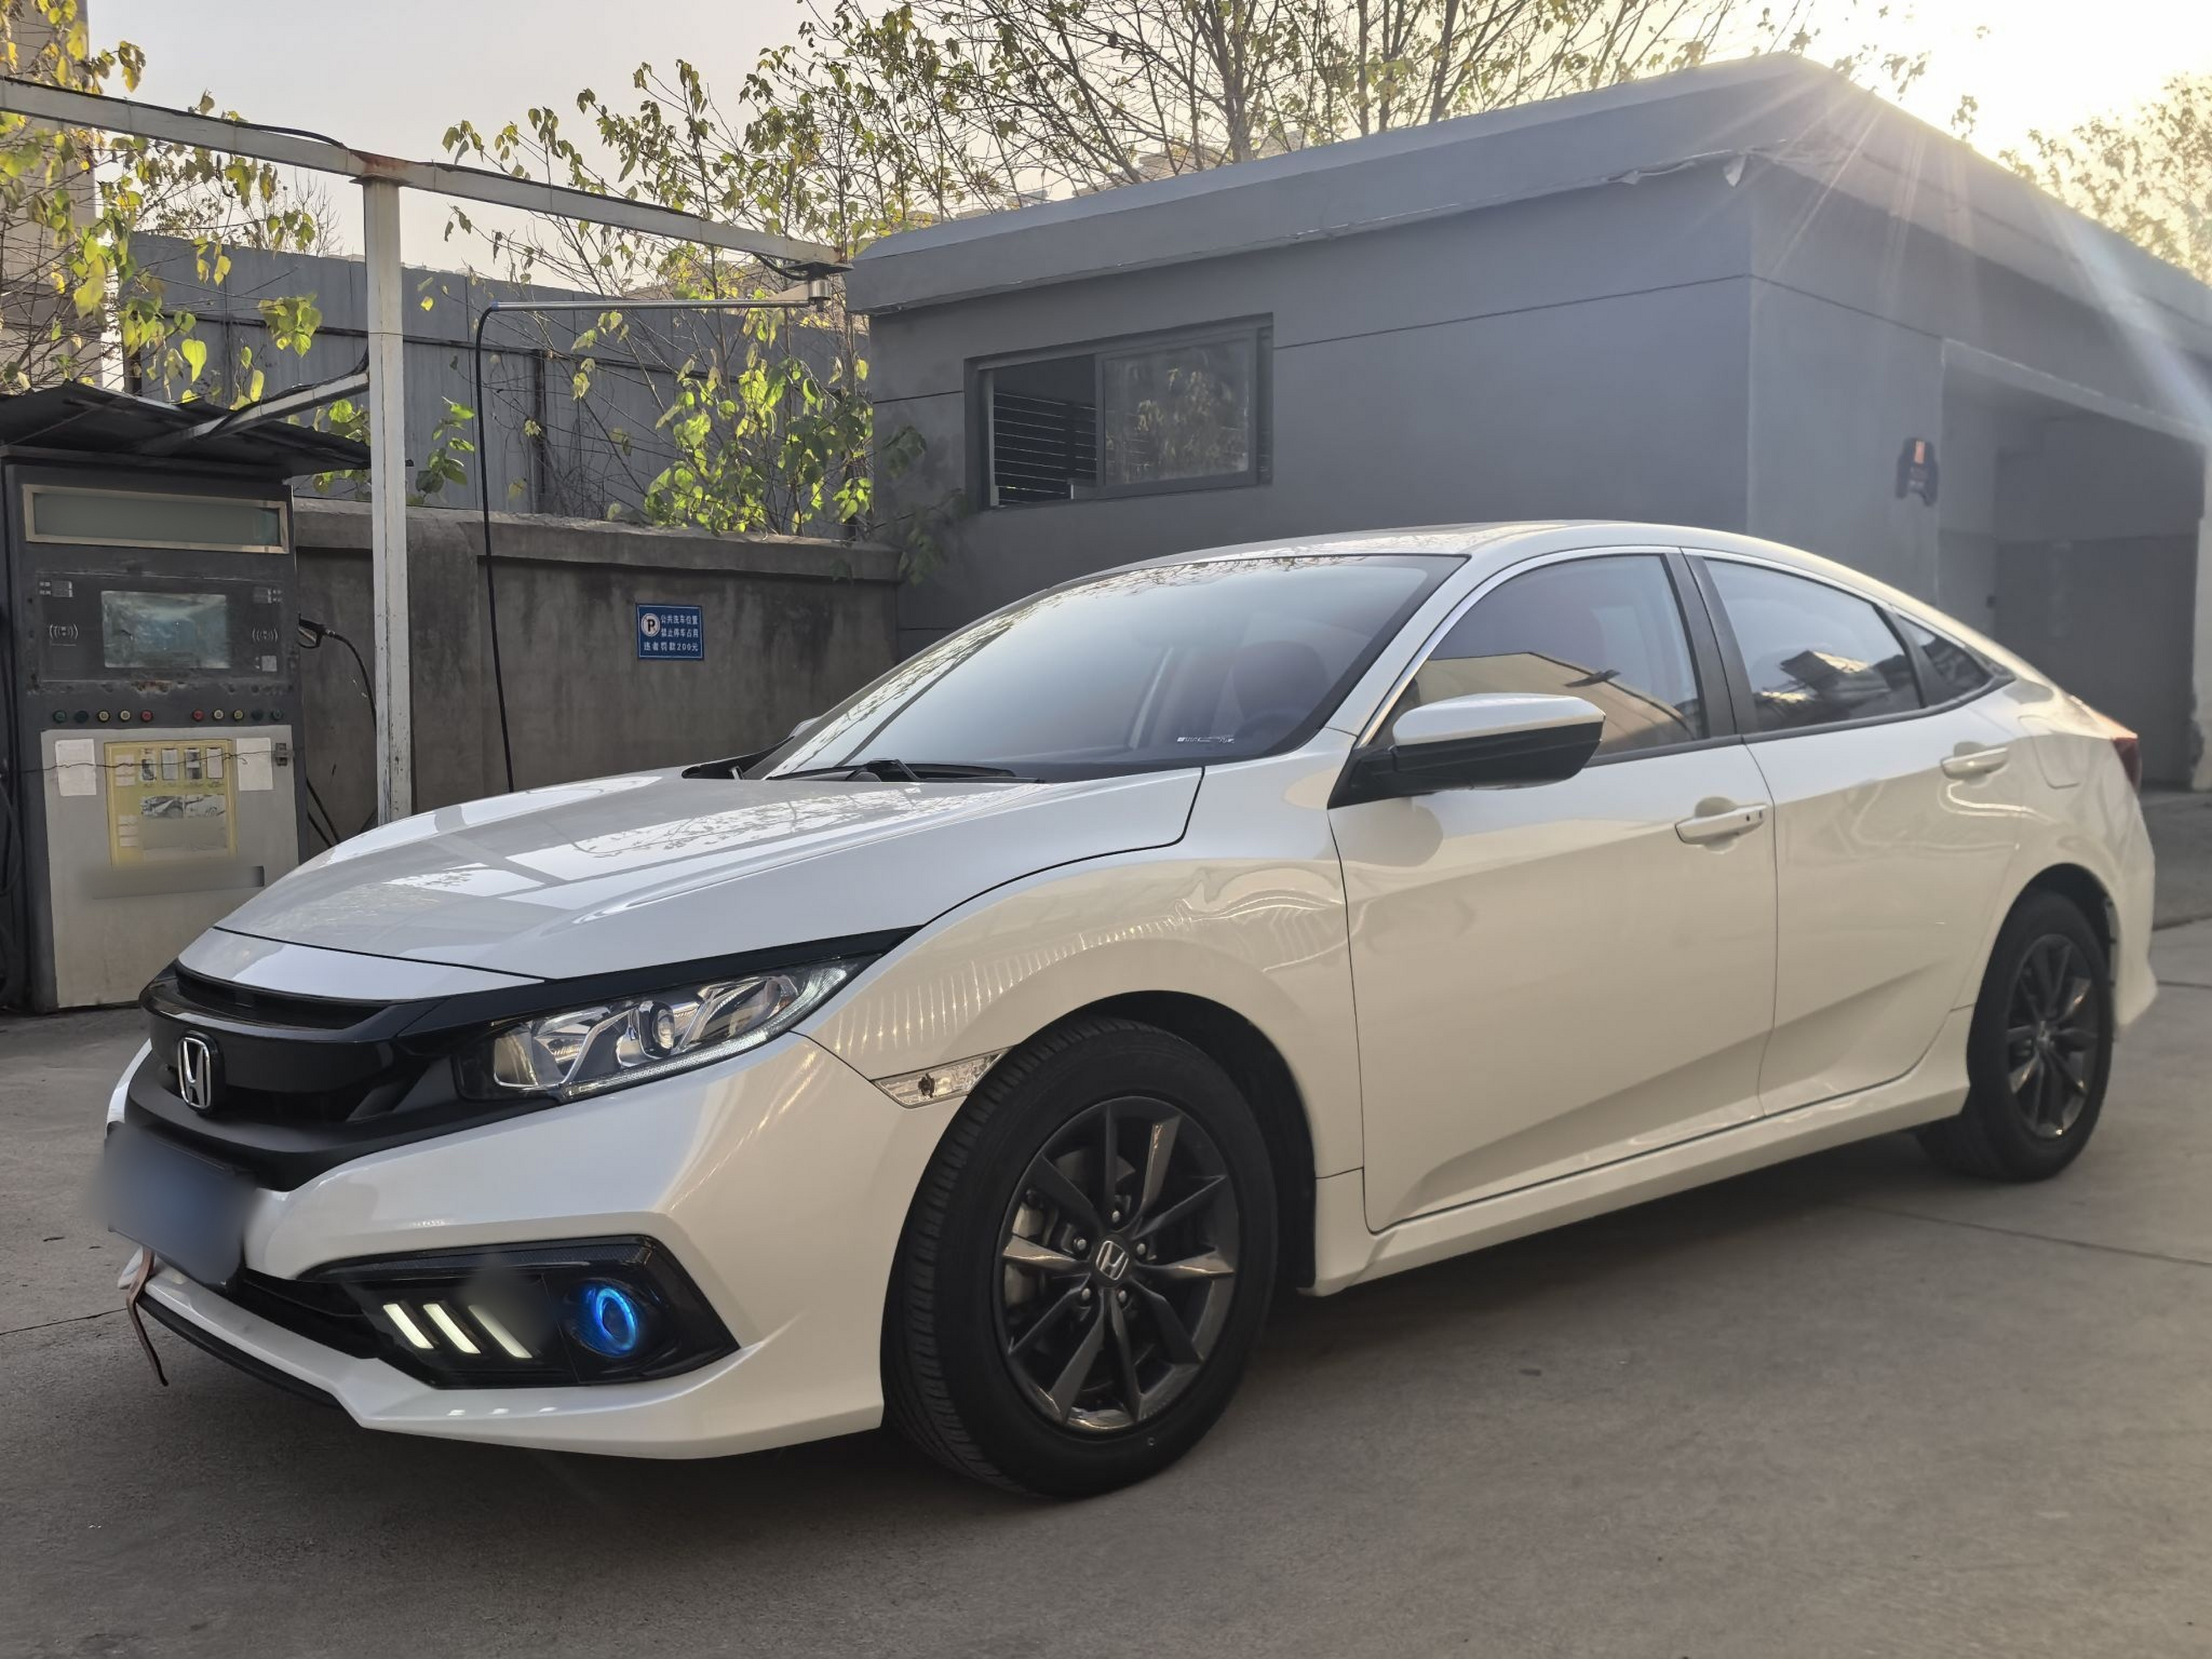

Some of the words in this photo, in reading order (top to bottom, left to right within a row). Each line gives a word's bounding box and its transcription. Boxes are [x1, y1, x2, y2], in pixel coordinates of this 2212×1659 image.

[661, 628, 699, 638] 禁止停车占用
[643, 641, 699, 652] 违者罚款200元
